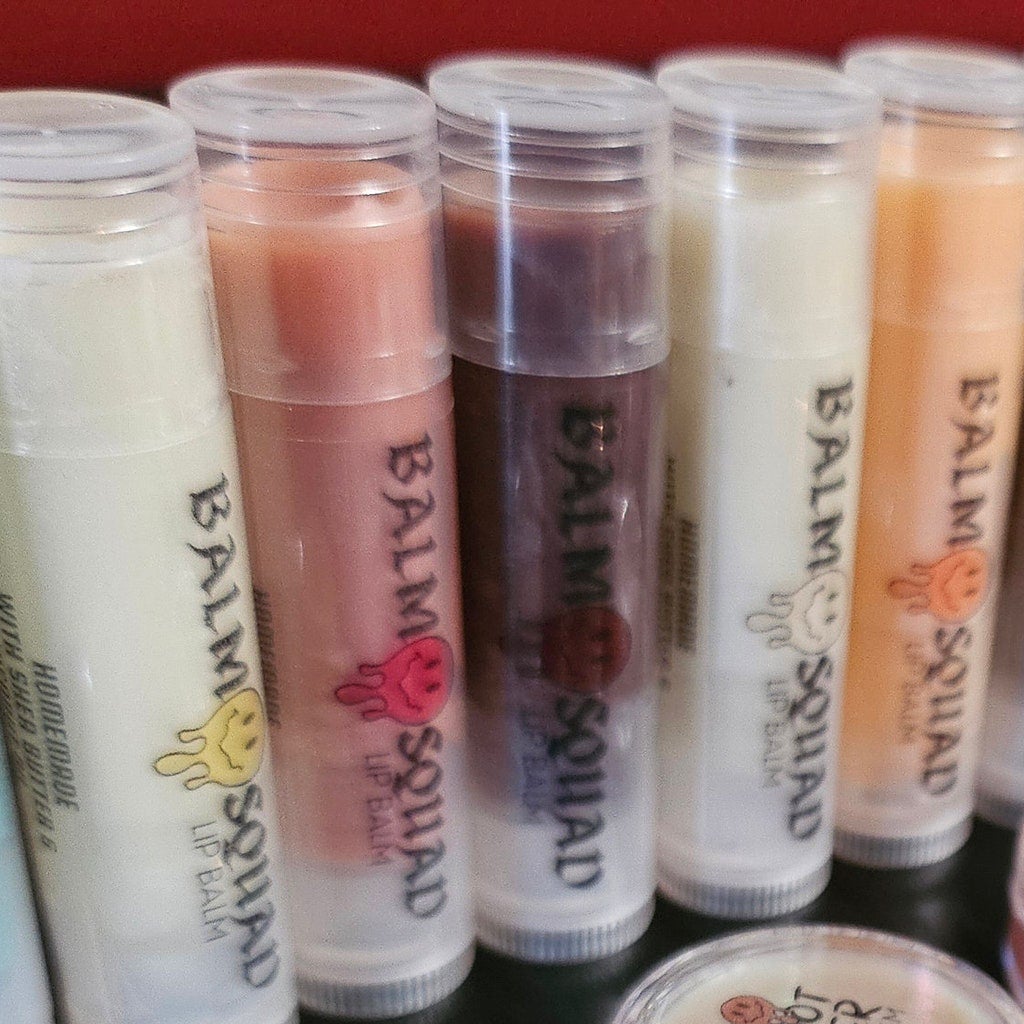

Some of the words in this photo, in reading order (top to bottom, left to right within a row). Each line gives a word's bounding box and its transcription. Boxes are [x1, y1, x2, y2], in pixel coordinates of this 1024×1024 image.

[381, 432, 439, 640] BALM
[553, 400, 618, 605] BALM
[806, 377, 854, 573] BALM
[947, 372, 999, 546] BALM
[8, 666, 37, 735] SHEA
[22, 737, 55, 831] BUTTER
[32, 660, 80, 811] HOMEMADE
[186, 473, 250, 699] BALM
[223, 783, 281, 990] SQUAD
[365, 753, 392, 796] LIP
[787, 653, 834, 843] SQUAD
[919, 626, 971, 797] SQUAD
[191, 820, 220, 862] LIP
[368, 797, 401, 867] BALM
[397, 725, 449, 920] SQUAD
[548, 696, 609, 890] SQUAD
[196, 864, 231, 944] BALM
